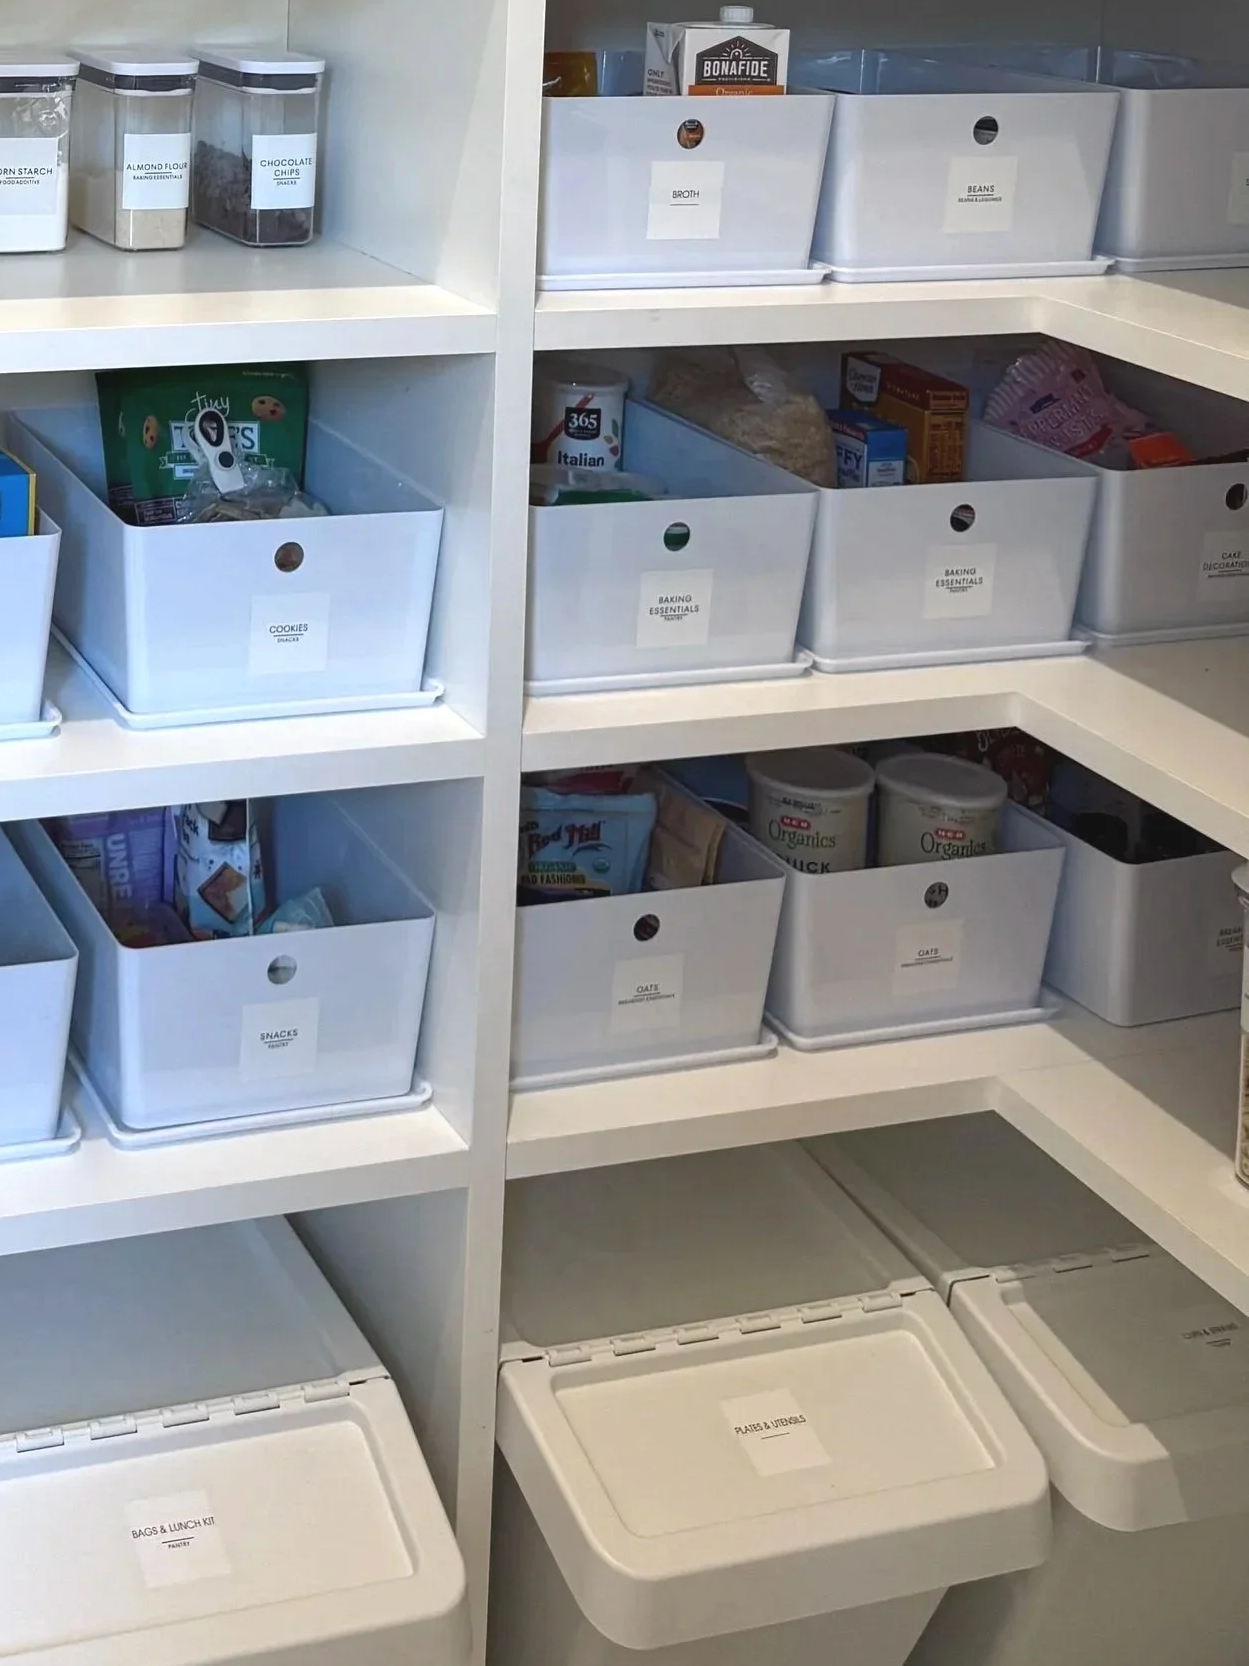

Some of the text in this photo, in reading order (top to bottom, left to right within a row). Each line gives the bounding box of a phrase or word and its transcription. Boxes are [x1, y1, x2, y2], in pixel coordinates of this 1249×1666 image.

[703, 60, 768, 77] BONAFIDE
[126, 162, 188, 171] ALMOND FLOUR
[260, 157, 312, 167] CHOCOLATE
[17, 167, 53, 176] STARCH
[274, 168, 300, 177] CHIPS
[671, 189, 699, 198] BROTH
[967, 185, 994, 194] BEANS
[190, 391, 230, 418] tiny
[568, 412, 598, 429] 365
[557, 450, 605, 467] Italian
[944, 568, 976, 577] BAKING
[935, 577, 983, 587] ESSENTIALS
[658, 595, 692, 604] BAKING
[649, 605, 699, 615] ESSENTIALS
[269, 623, 308, 634] COOKIES
[768, 820, 836, 849] Organics
[921, 831, 987, 860] Organics
[917, 948, 939, 957] OATS
[636, 983, 659, 994] OATS
[259, 1028, 298, 1041] SNACKS
[734, 1414, 807, 1435] PLATES & UTENSILS
[131, 1516, 215, 1539] BAGS & LUNCH KIT
[168, 1541, 190, 1550] PANTRY
